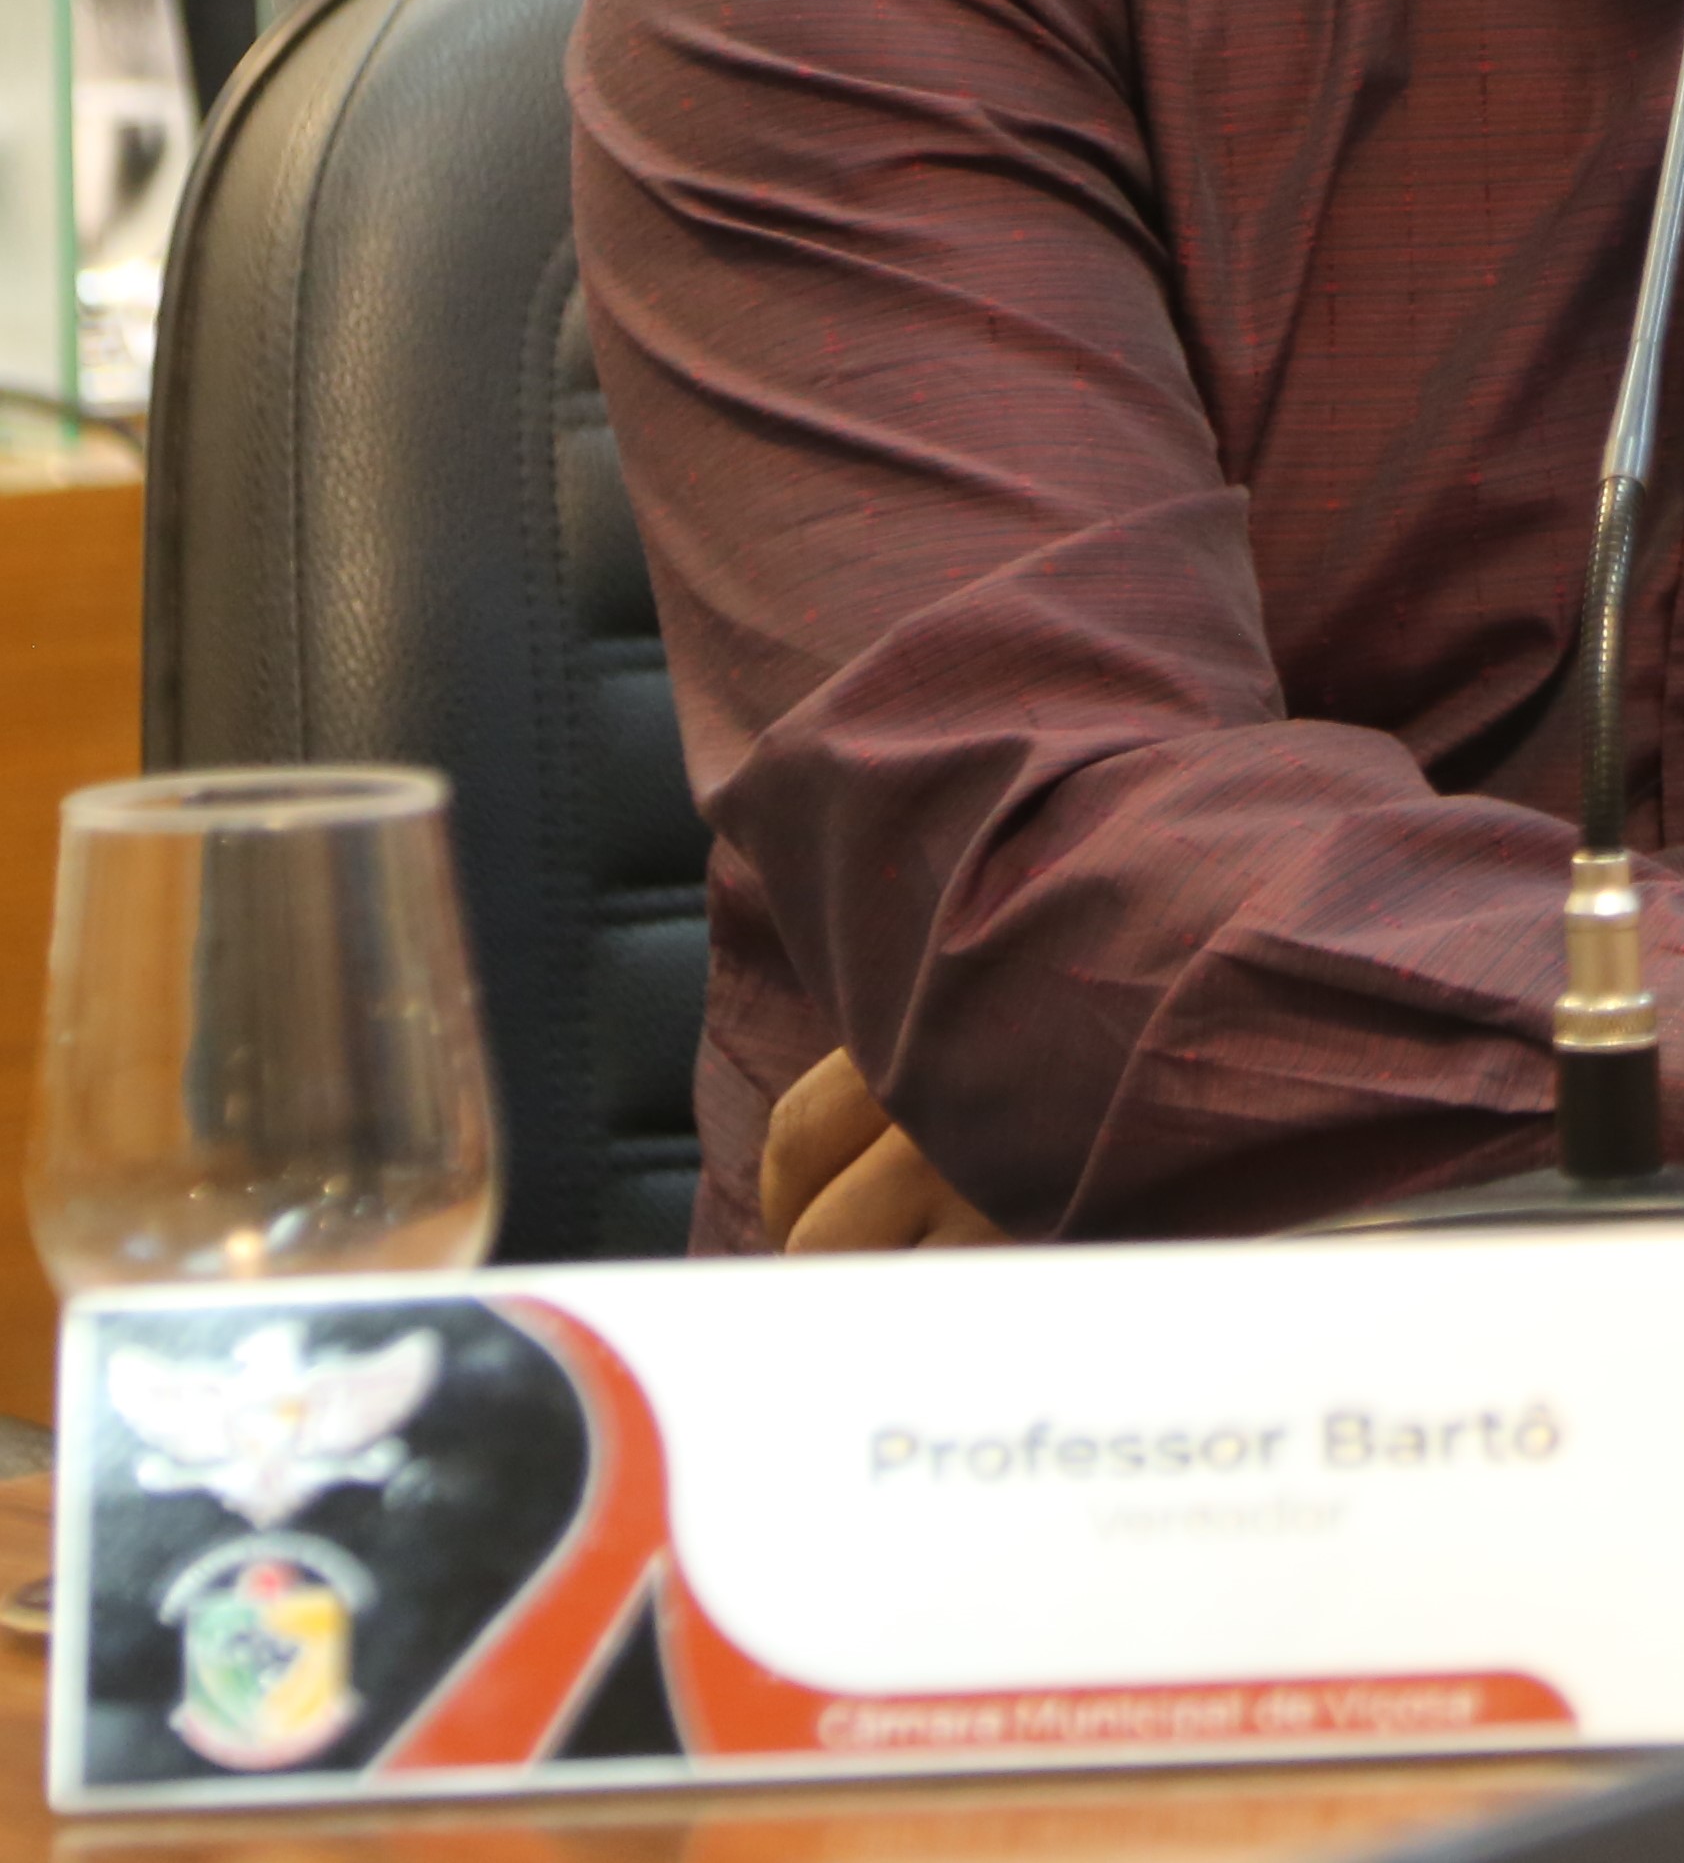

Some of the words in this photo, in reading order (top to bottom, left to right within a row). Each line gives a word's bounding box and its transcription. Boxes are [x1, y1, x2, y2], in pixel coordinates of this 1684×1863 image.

[868, 1417, 1288, 1483] Professor
[1320, 1401, 1563, 1470] Bartô
[1013, 1689, 1240, 1742] Municipal
[1251, 1685, 1316, 1734] de
